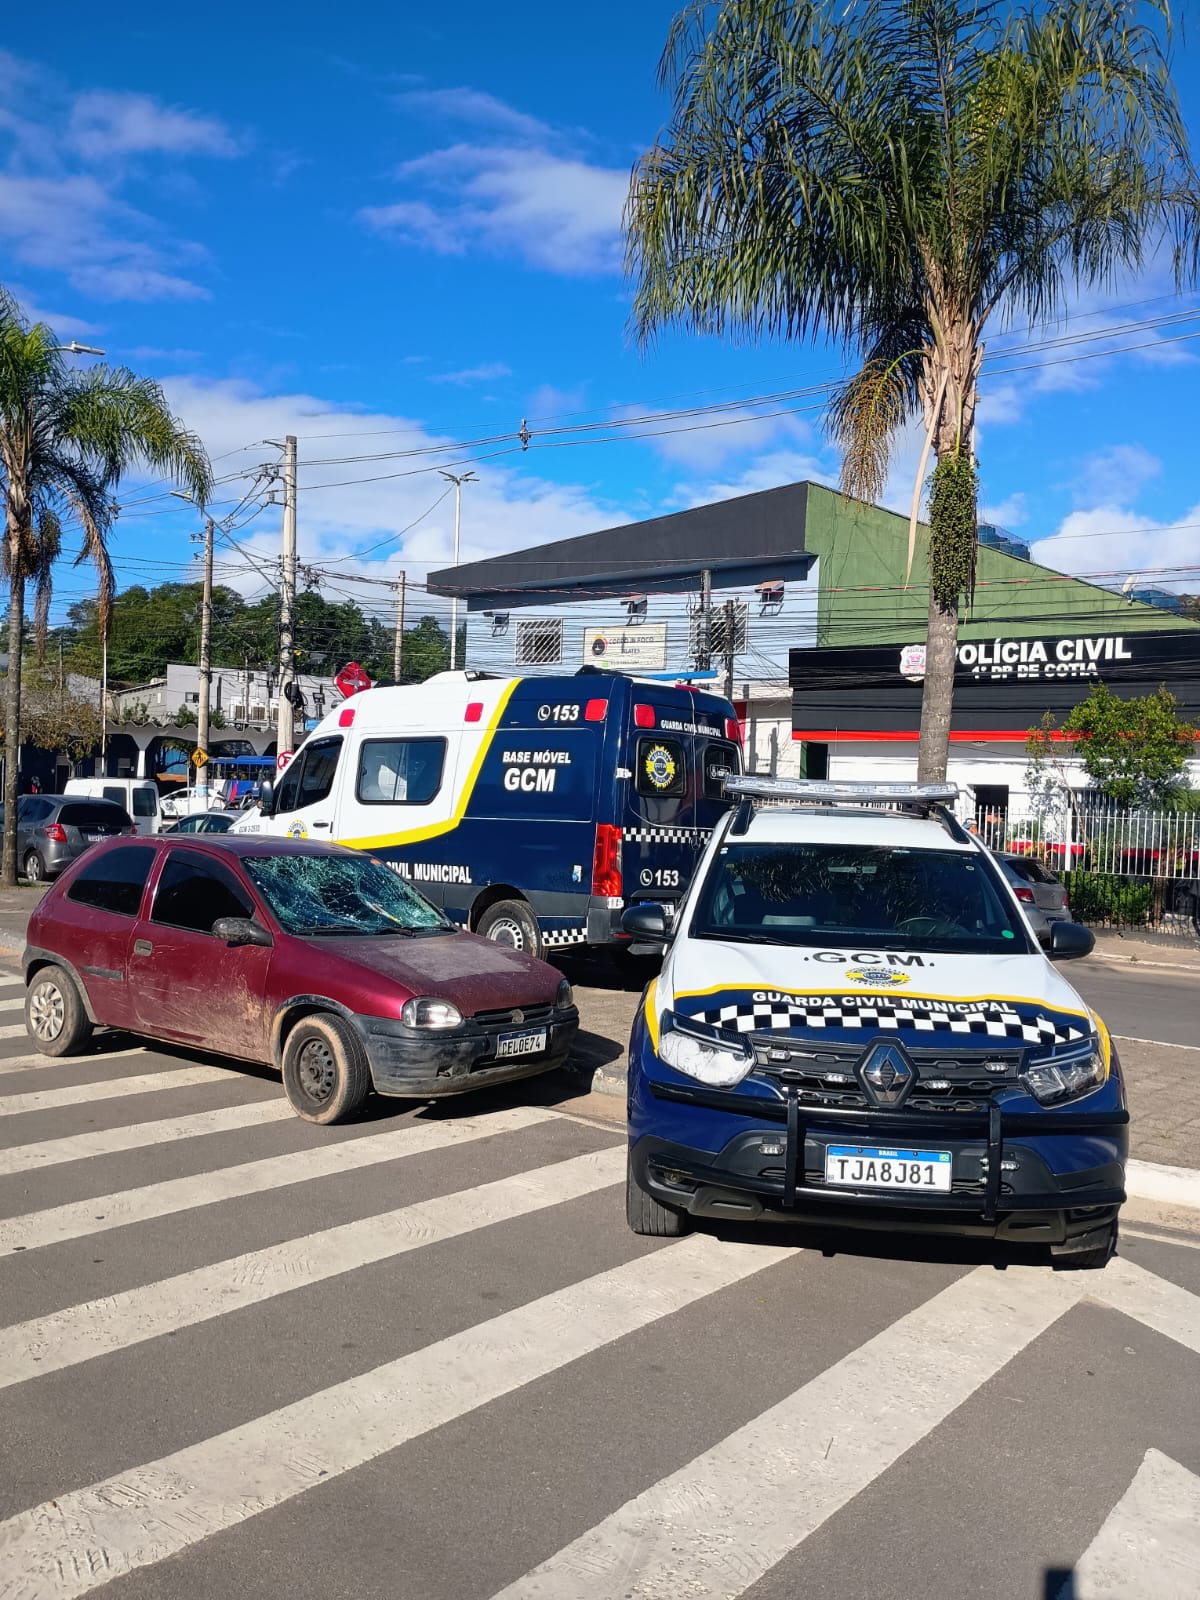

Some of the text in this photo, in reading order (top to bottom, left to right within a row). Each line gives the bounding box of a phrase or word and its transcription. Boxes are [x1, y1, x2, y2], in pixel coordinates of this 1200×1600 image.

[955, 637, 1132, 665] OLÍCIA CIVIL
[991, 665, 1014, 679] DP
[1017, 664, 1040, 678] DE
[1044, 662, 1099, 677] COTIA
[552, 704, 580, 721] 153
[660, 719, 722, 737] GUARDA CIVIL MUNICIPAL
[502, 749, 571, 764] BASE MÓVEL
[504, 767, 556, 792] GCM
[414, 863, 473, 884] MUNICIPAL
[654, 869, 679, 886] 153
[752, 991, 1017, 1014] GUARDA CIVIL MUNICIPAL
[837, 1158, 936, 1186] TJA8J81
